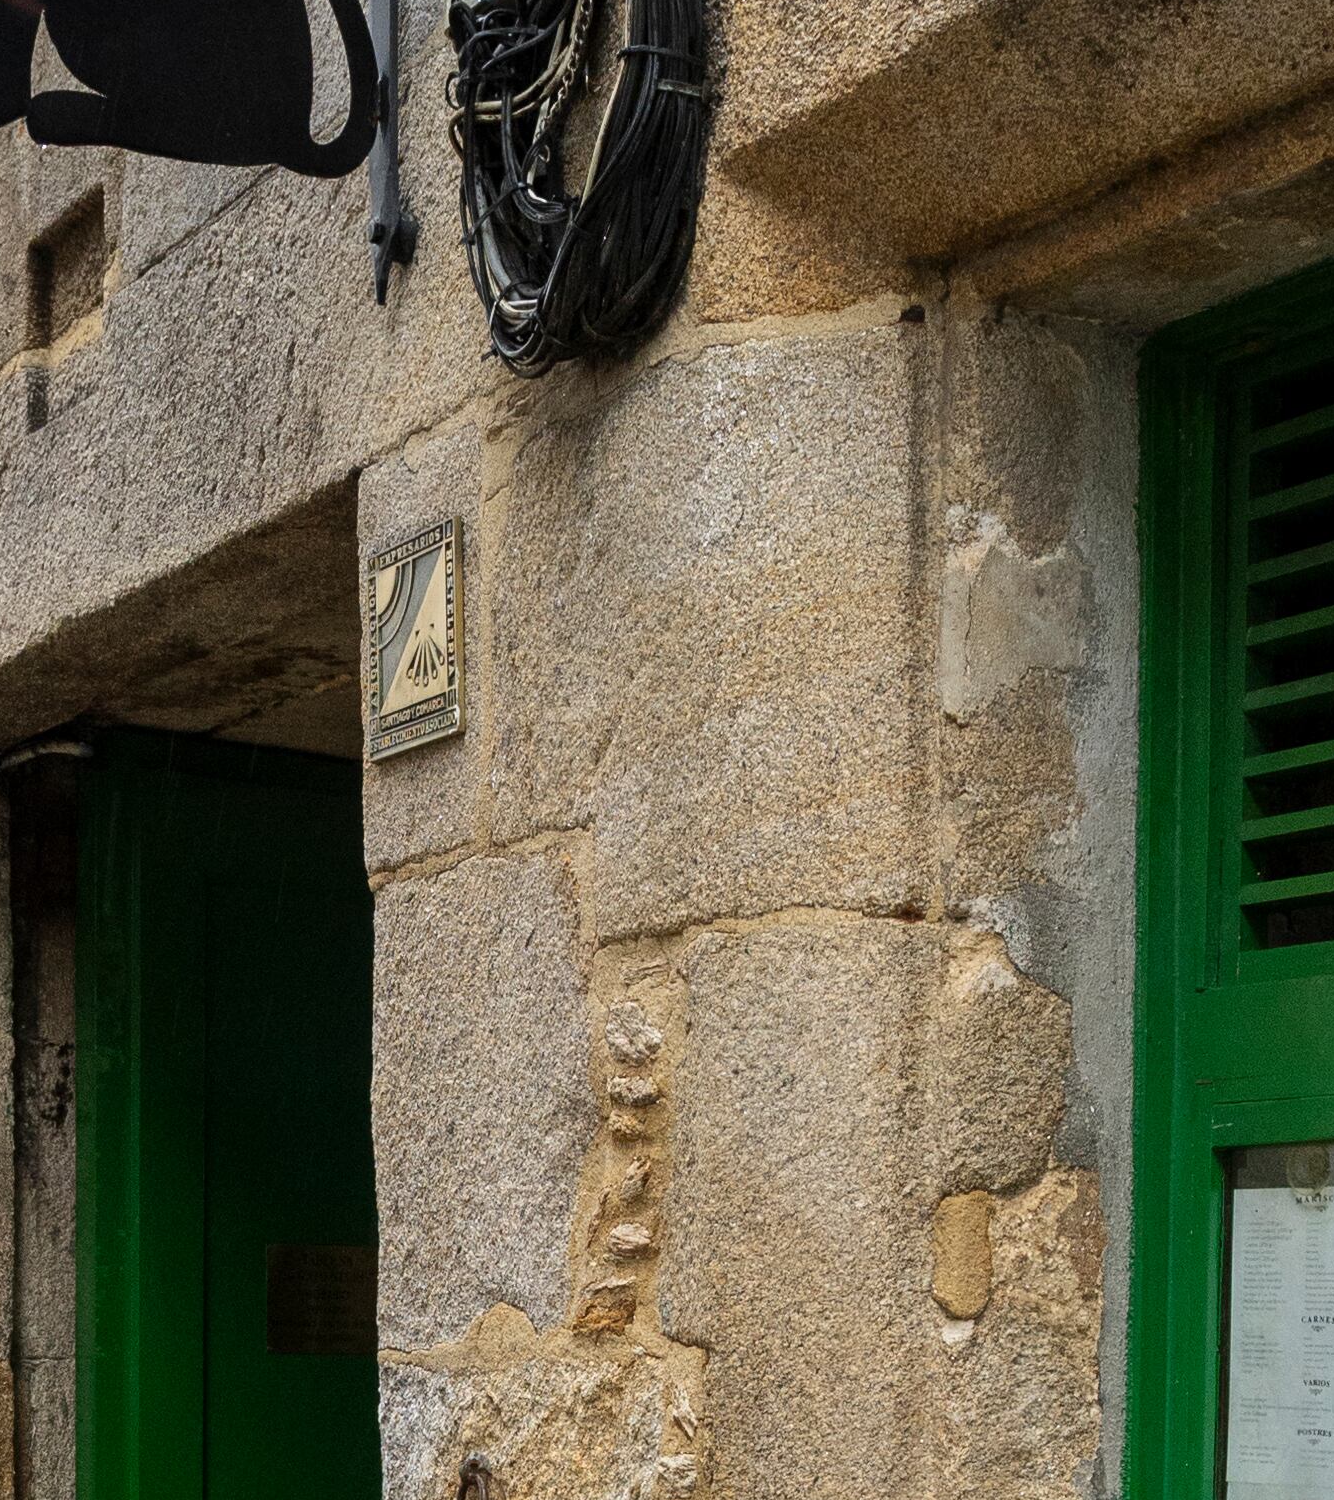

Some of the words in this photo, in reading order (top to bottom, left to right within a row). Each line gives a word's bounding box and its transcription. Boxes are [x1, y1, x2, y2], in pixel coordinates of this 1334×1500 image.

[379, 527, 441, 568] EMPRESARIOS
[446, 550, 455, 682] HOSTELERIA
[381, 709, 410, 730] SANTIAGO
[415, 698, 445, 718] COMARCA
[1303, 1379, 1331, 1387] VARIOS
[1296, 1429, 1332, 1438] POSTRES
